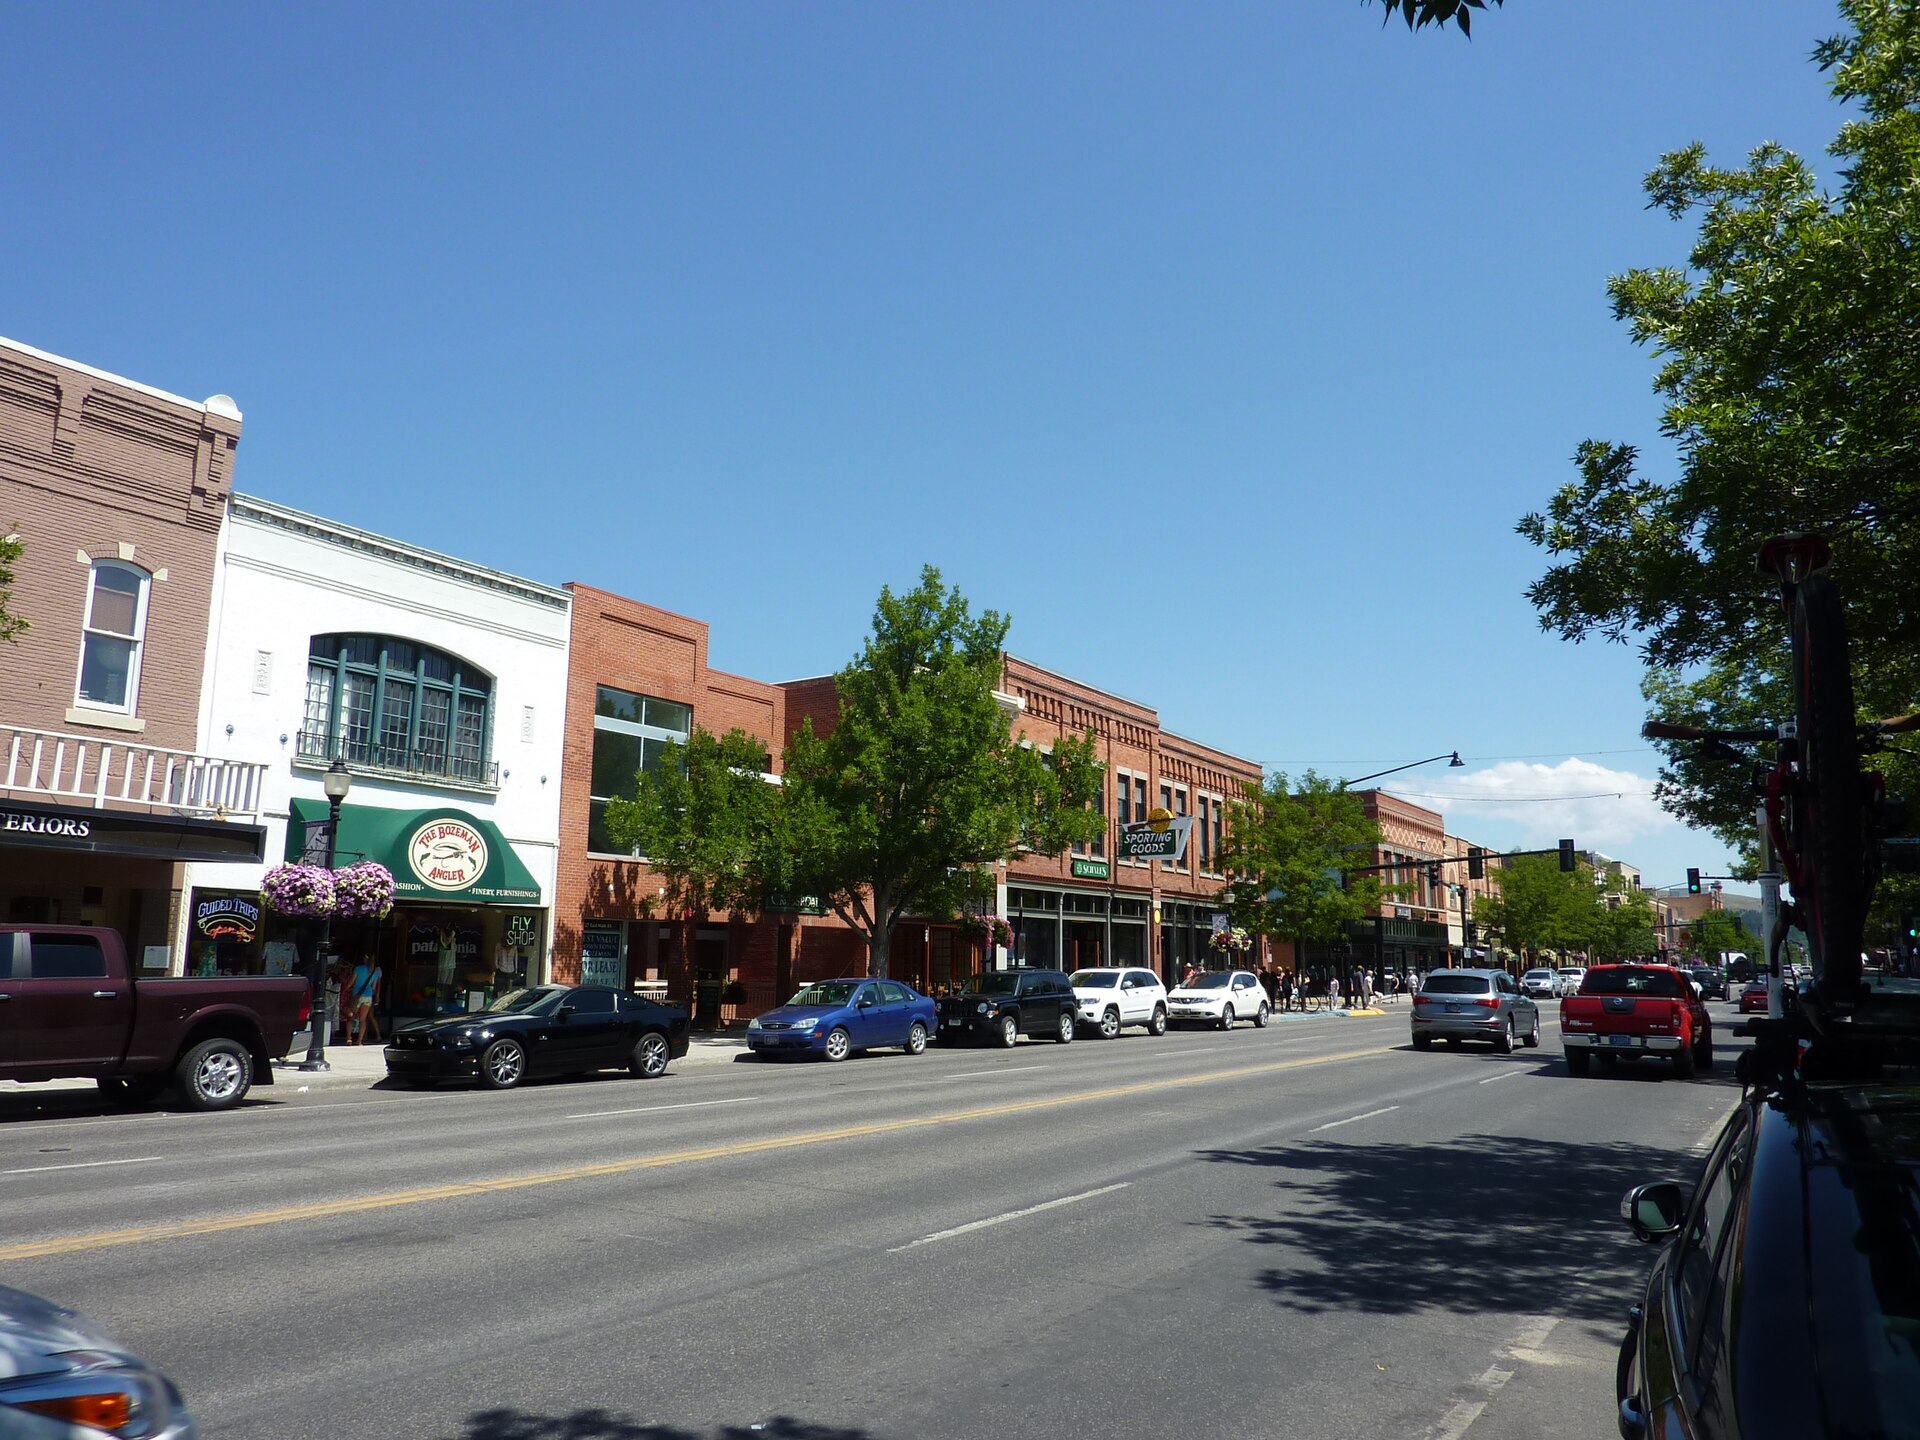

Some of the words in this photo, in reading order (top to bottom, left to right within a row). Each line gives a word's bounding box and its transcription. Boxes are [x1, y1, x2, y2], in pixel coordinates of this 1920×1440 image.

[418, 829, 437, 849] THE
[437, 826, 480, 853] BOZEMAN
[1124, 833, 1172, 844] SPORTING
[1130, 843, 1165, 854] GOODS
[428, 866, 466, 882] ANGLER
[496, 889, 537, 898] FURNISHINGS
[198, 899, 233, 917] GUIDED
[233, 898, 259, 920] TRIPS
[512, 916, 532, 931] FLY
[506, 930, 536, 946] SHOP
[411, 941, 477, 955] patania
[582, 960, 593, 973] OR
[595, 961, 618, 973] LEASE
